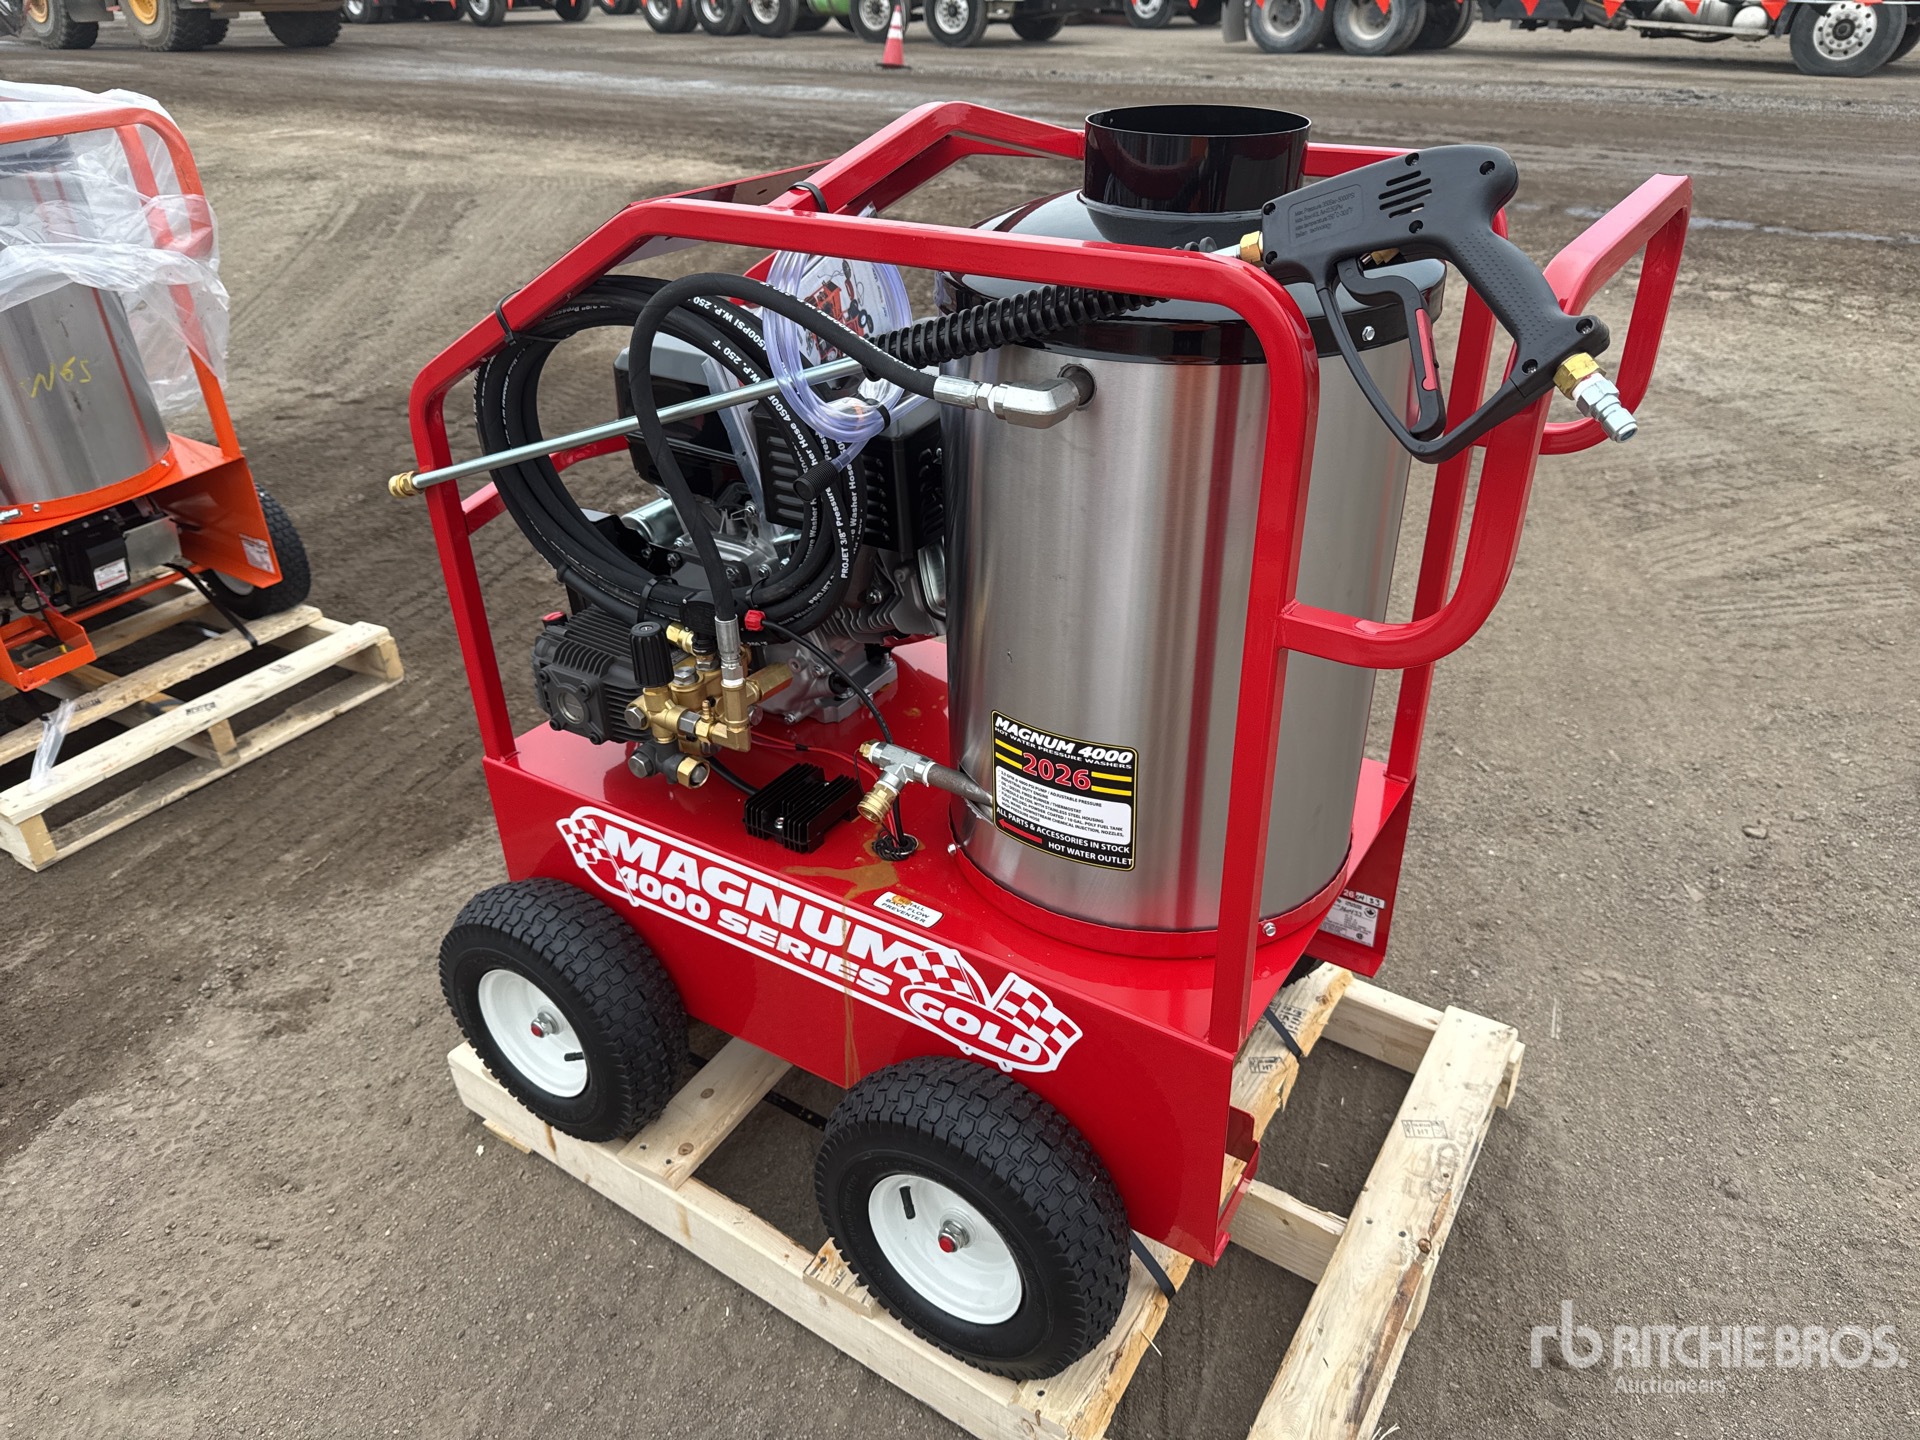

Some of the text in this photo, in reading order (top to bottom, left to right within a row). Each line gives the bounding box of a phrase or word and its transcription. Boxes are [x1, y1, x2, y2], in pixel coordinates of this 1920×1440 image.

[692, 296, 712, 310] 250
[722, 347, 742, 365] 250
[790, 422, 809, 449] Hose
[846, 463, 857, 490] Hose
[825, 486, 844, 527] Pressure
[849, 491, 858, 527] Washer
[809, 506, 818, 538] Washer
[840, 547, 849, 579] PROJET
[808, 580, 832, 605] PROJET
[995, 716, 1133, 764] MAGNUM 4000
[995, 726, 1132, 770] HOT WATER PRESSURE WASHERS
[1022, 752, 1091, 790] 2026
[1033, 790, 1049, 799] ENGINE
[1033, 796, 1050, 805] BURNER
[1053, 802, 1082, 813] THERMOSTAT
[1035, 785, 1048, 793] PUMP
[1050, 791, 1078, 803] ADJUSTABLE
[1078, 799, 1102, 807] PRESSURE
[1011, 806, 1029, 817] PRESSURE
[1022, 807, 1052, 820] DOWNSTREAM
[1052, 818, 1074, 828] CHEMICAL
[1028, 803, 1046, 814] POWDER
[1047, 811, 1064, 819] COATED
[1045, 805, 1067, 816] STAINLESS
[1082, 816, 1104, 824] HOUSING
[996, 807, 1130, 854] ALL PARTS & ACCESSORIES IN STOCK
[1048, 841, 1133, 865] HOT WATER OUTLET
[602, 824, 924, 977] MAGNUM
[881, 902, 926, 923] PREVENTER
[885, 899, 930, 918] BACK FLOW
[615, 866, 894, 996] 4000 SERIES
[909, 992, 1042, 1062] GOLD
